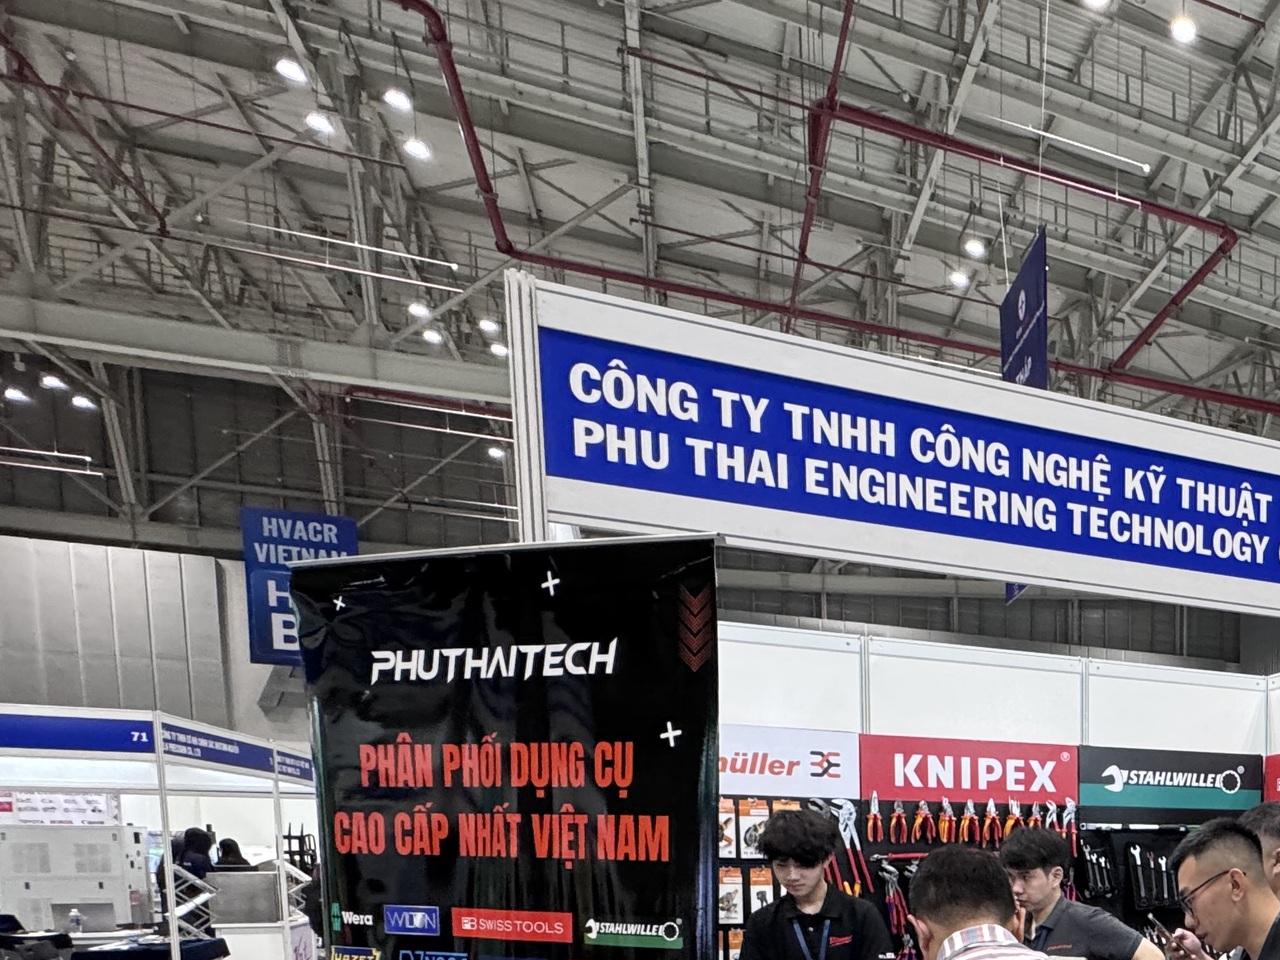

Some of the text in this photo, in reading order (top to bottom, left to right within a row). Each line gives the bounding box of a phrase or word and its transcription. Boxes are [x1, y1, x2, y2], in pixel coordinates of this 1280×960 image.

[569, 359, 698, 422] CÔNG
[712, 389, 769, 433] TY
[784, 403, 896, 458] TNHH
[910, 424, 1009, 477] CÔNG
[1022, 448, 1111, 501] NGHỆ
[1125, 465, 1165, 505] KỸ
[1177, 477, 1273, 524] THUẬT
[573, 417, 670, 470] PHU
[685, 437, 788, 489] THAI
[805, 458, 1056, 532] ENGINEERING
[1067, 502, 1270, 564] TECHNOLOGY
[262, 516, 338, 544] HVACR
[371, 637, 618, 685] PHUTHAITECH
[131, 731, 148, 743] 71
[359, 731, 634, 798] PHÂN PHỐI DỤNG CỤ
[894, 753, 1056, 793] KNIPEX
[1127, 770, 1222, 788] STAHLWILLE
[334, 802, 669, 870] CAO CẤP NHẤT VIỆT NAM
[342, 911, 373, 926] Wera
[479, 919, 512, 931] SWISS
[514, 920, 564, 934] TOOLS
[600, 922, 664, 937] STAHLWILLE
